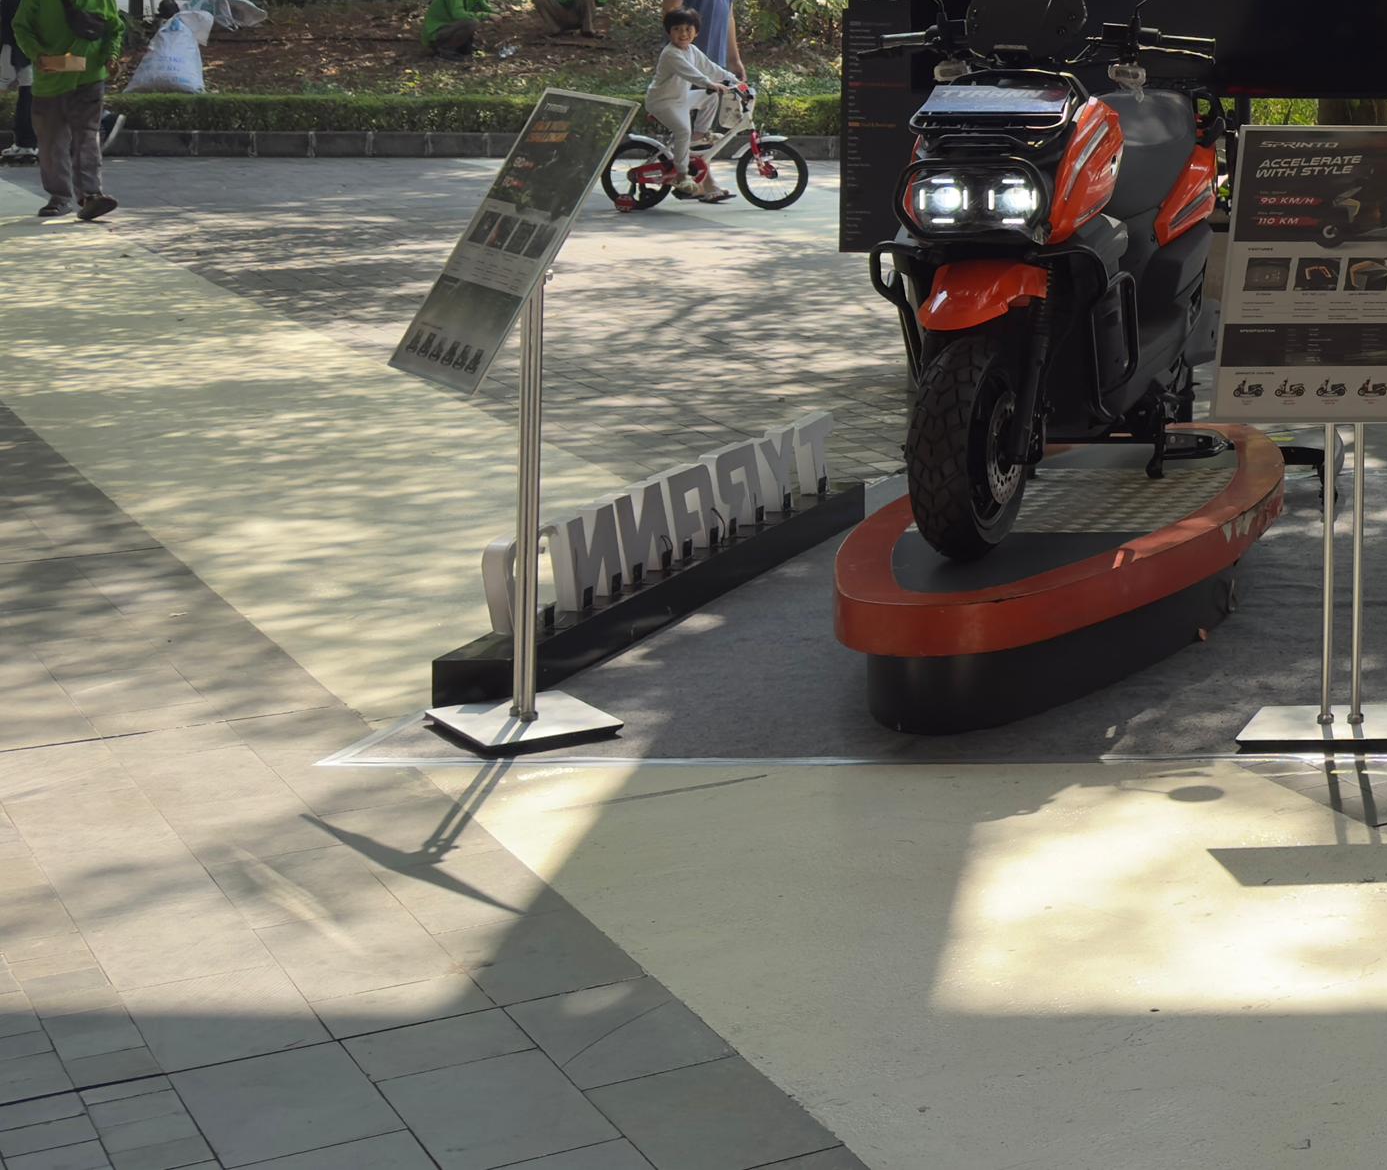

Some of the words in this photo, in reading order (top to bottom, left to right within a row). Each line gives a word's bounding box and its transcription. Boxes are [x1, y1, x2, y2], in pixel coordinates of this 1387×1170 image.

[1256, 140, 1340, 150] SPRINTO
[1258, 155, 1364, 169] ACCELERATE
[1255, 167, 1298, 178] WITH
[1299, 165, 1354, 177] STYLE
[1257, 217, 1275, 225] 110
[1278, 217, 1300, 225] KM
